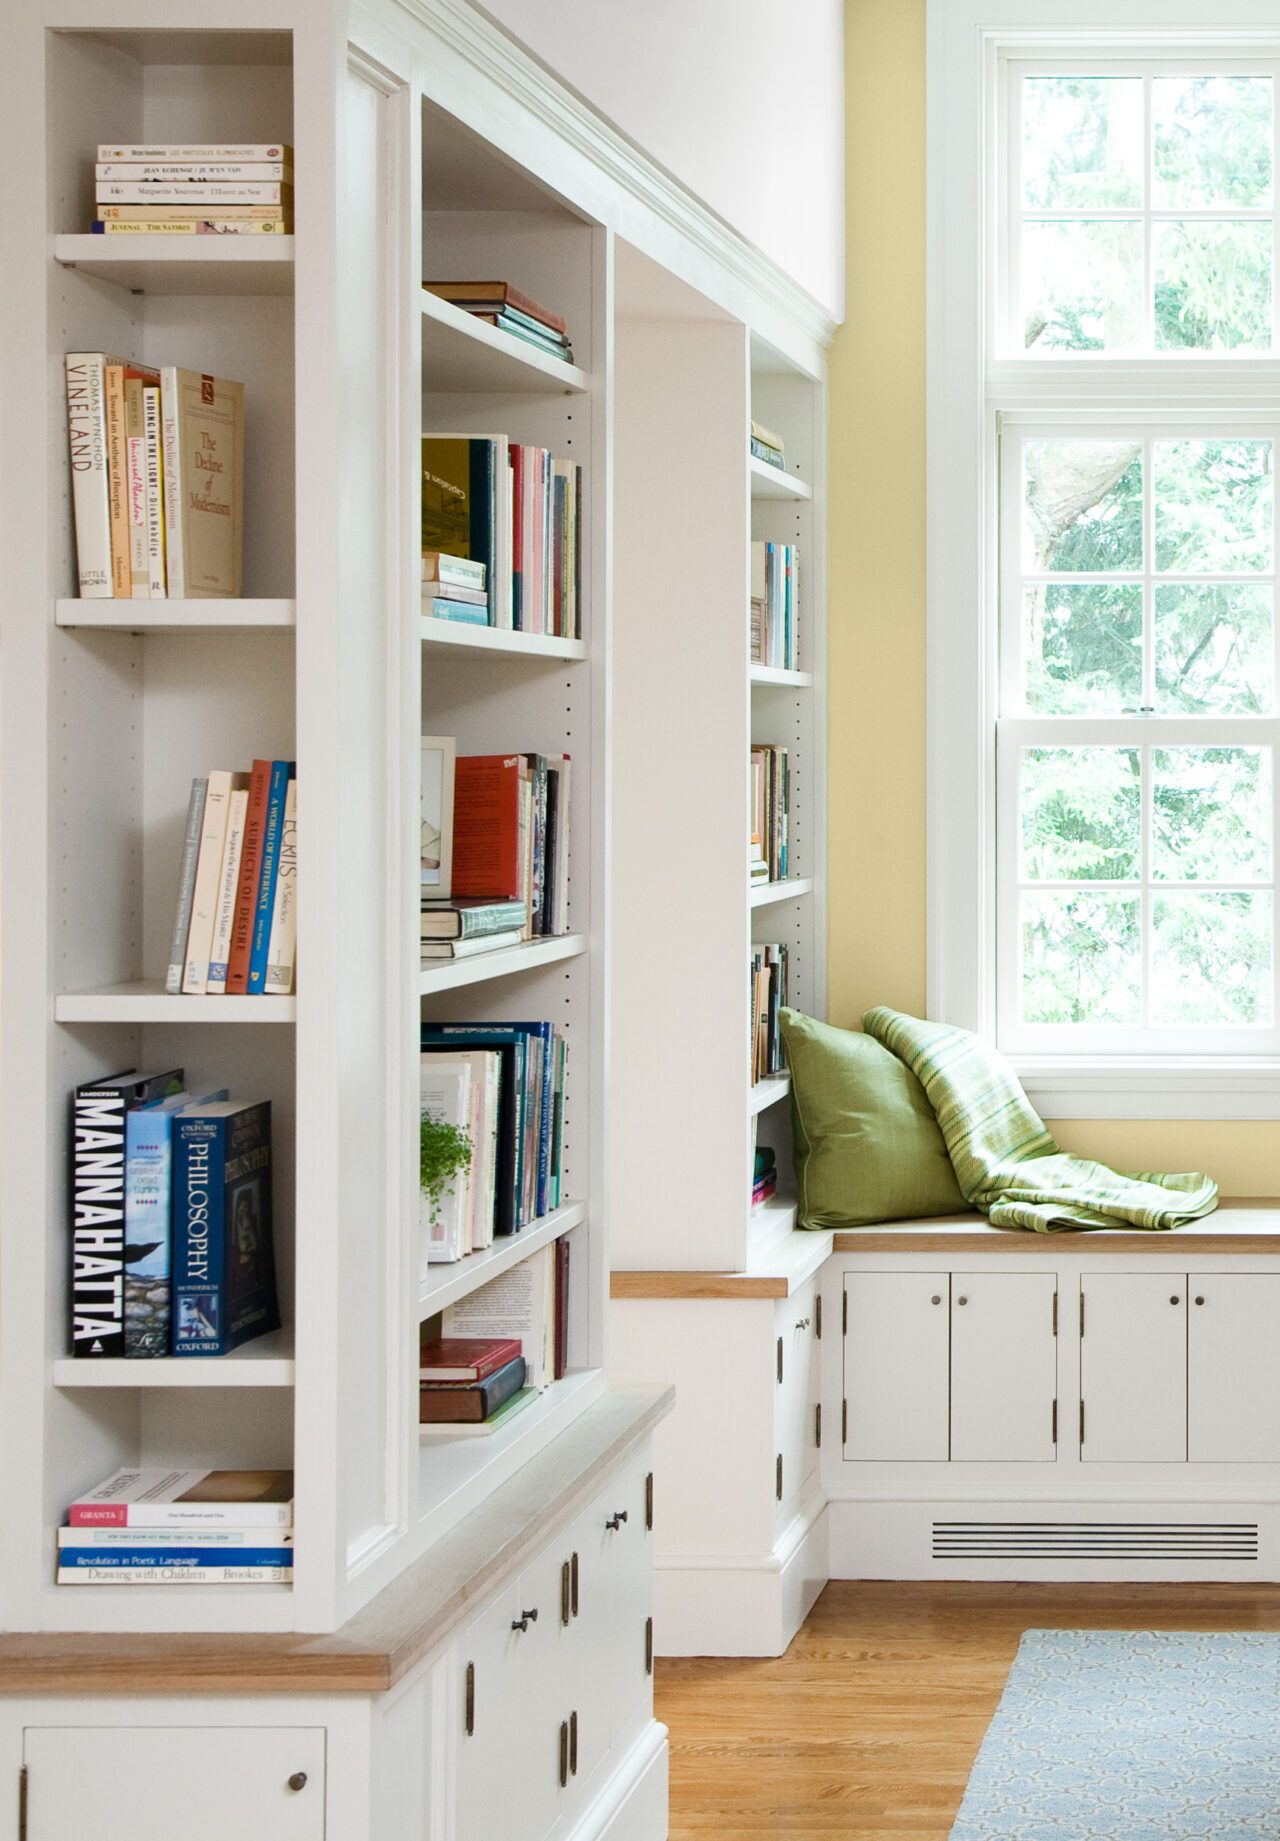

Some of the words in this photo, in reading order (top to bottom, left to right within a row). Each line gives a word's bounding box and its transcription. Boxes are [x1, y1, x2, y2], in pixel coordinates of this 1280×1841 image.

[90, 363, 102, 412] THOMAS
[67, 364, 92, 472] VINELAND
[110, 394, 119, 420] Toward
[146, 396, 156, 428] HIDING
[112, 423, 118, 434] an
[148, 430, 156, 440] IN
[165, 418, 176, 434] The
[92, 416, 104, 471] PYNCHON
[112, 436, 121, 470] Aesthetic
[148, 443, 157, 460] THE
[166, 436, 176, 467] Decline
[200, 432, 216, 452] The
[130, 438, 143, 480] Universal
[195, 452, 224, 474] Decline
[112, 471, 121, 480] of
[148, 462, 158, 488] LIGHT
[113, 481, 121, 520] Reception
[132, 482, 144, 526] Abandon?
[150, 498, 158, 517] Dick
[168, 482, 178, 529] Modernism
[190, 491, 231, 516] Modernism
[267, 807, 278, 839] WORLD
[244, 820, 259, 882] SUBJECTS
[267, 842, 274, 853] OF
[243, 885, 252, 900] OF
[260, 856, 273, 910] DIFFERENCE
[236, 906, 250, 951] DESIRE
[74, 1099, 124, 1340] MANNAHATTA
[188, 1143, 210, 1281] PHILOSOPHY
[176, 1342, 220, 1352] OXFORD
[80, 1511, 116, 1520] GRANTA
[77, 1557, 120, 1566] Revolution
[122, 1557, 130, 1565] in
[132, 1557, 156, 1566] Poetic
[160, 1558, 200, 1568] Language
[89, 1568, 132, 1581] Drawing
[136, 1568, 158, 1580] with
[161, 1568, 206, 1580] Children
[224, 1568, 264, 1580] Brookes
